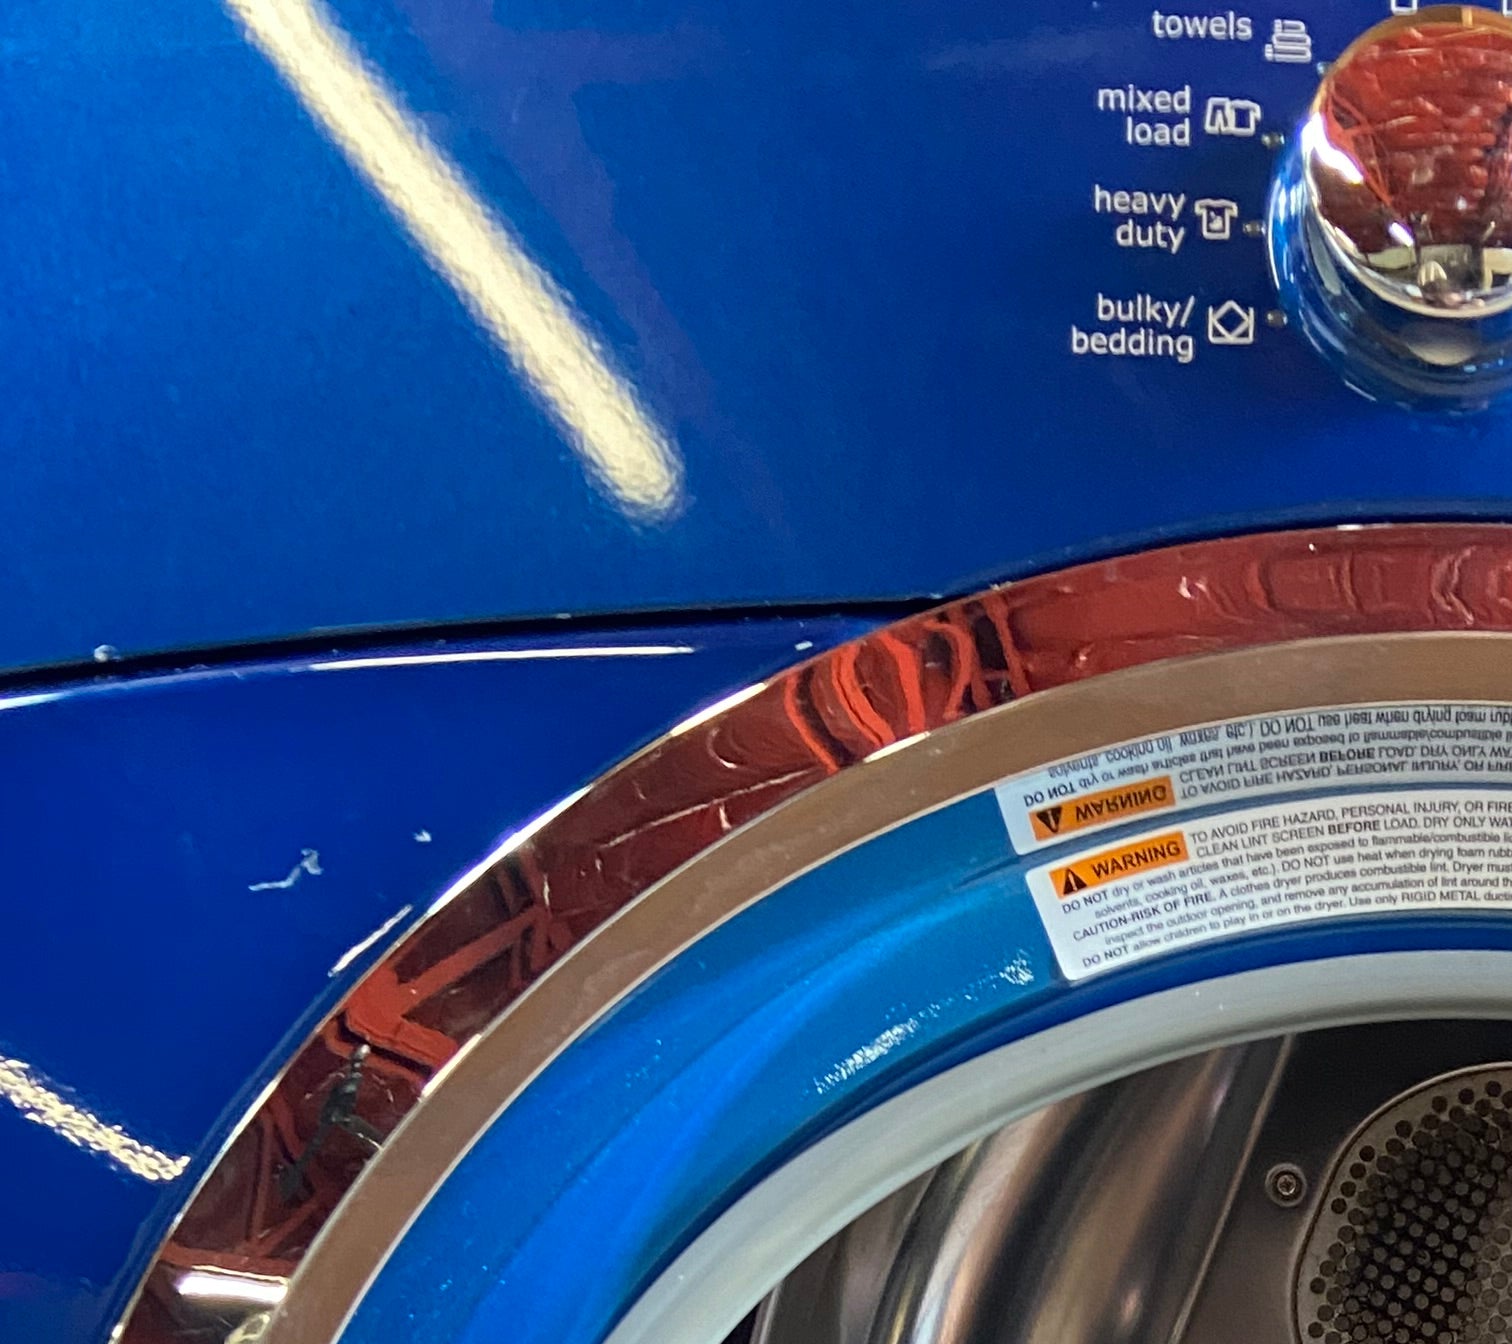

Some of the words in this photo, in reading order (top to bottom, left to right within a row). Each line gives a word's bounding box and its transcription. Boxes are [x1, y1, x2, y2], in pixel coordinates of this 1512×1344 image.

[1152, 11, 1252, 42] towels
[1098, 86, 1191, 114] mixed
[1125, 118, 1191, 147] load
[1094, 192, 1186, 220] heavy
[1116, 219, 1186, 251] duty
[1098, 296, 1195, 326] bulky/
[1072, 329, 1195, 362] bedding
[1189, 830, 1208, 845] TO
[1211, 823, 1249, 840] AVOID
[1252, 816, 1280, 829] FIRE
[1284, 810, 1338, 825] HAZARD,
[1341, 804, 1408, 818] PERSONAL
[1413, 802, 1462, 814] INJURY,
[1464, 802, 1483, 812] OR
[1196, 840, 1239, 859] CLEAN
[1242, 836, 1268, 848] LINT
[1272, 826, 1324, 843] SCREEN
[1328, 820, 1380, 834] BEFORE
[1423, 817, 1449, 828] DRY
[1453, 816, 1486, 828] ONLY
[1062, 900, 1081, 914] DO
[1084, 891, 1108, 906] NOT
[1112, 885, 1129, 898] dry
[1133, 880, 1144, 891] or
[1149, 872, 1175, 886] wash
[1179, 862, 1219, 878] articles
[1222, 856, 1244, 868] that
[1247, 851, 1273, 863] have
[1276, 843, 1305, 858] been
[1308, 838, 1355, 855] exposed
[1358, 836, 1369, 848] to
[1372, 831, 1500, 845] flammable/combustible
[1092, 841, 1181, 878] WARNING
